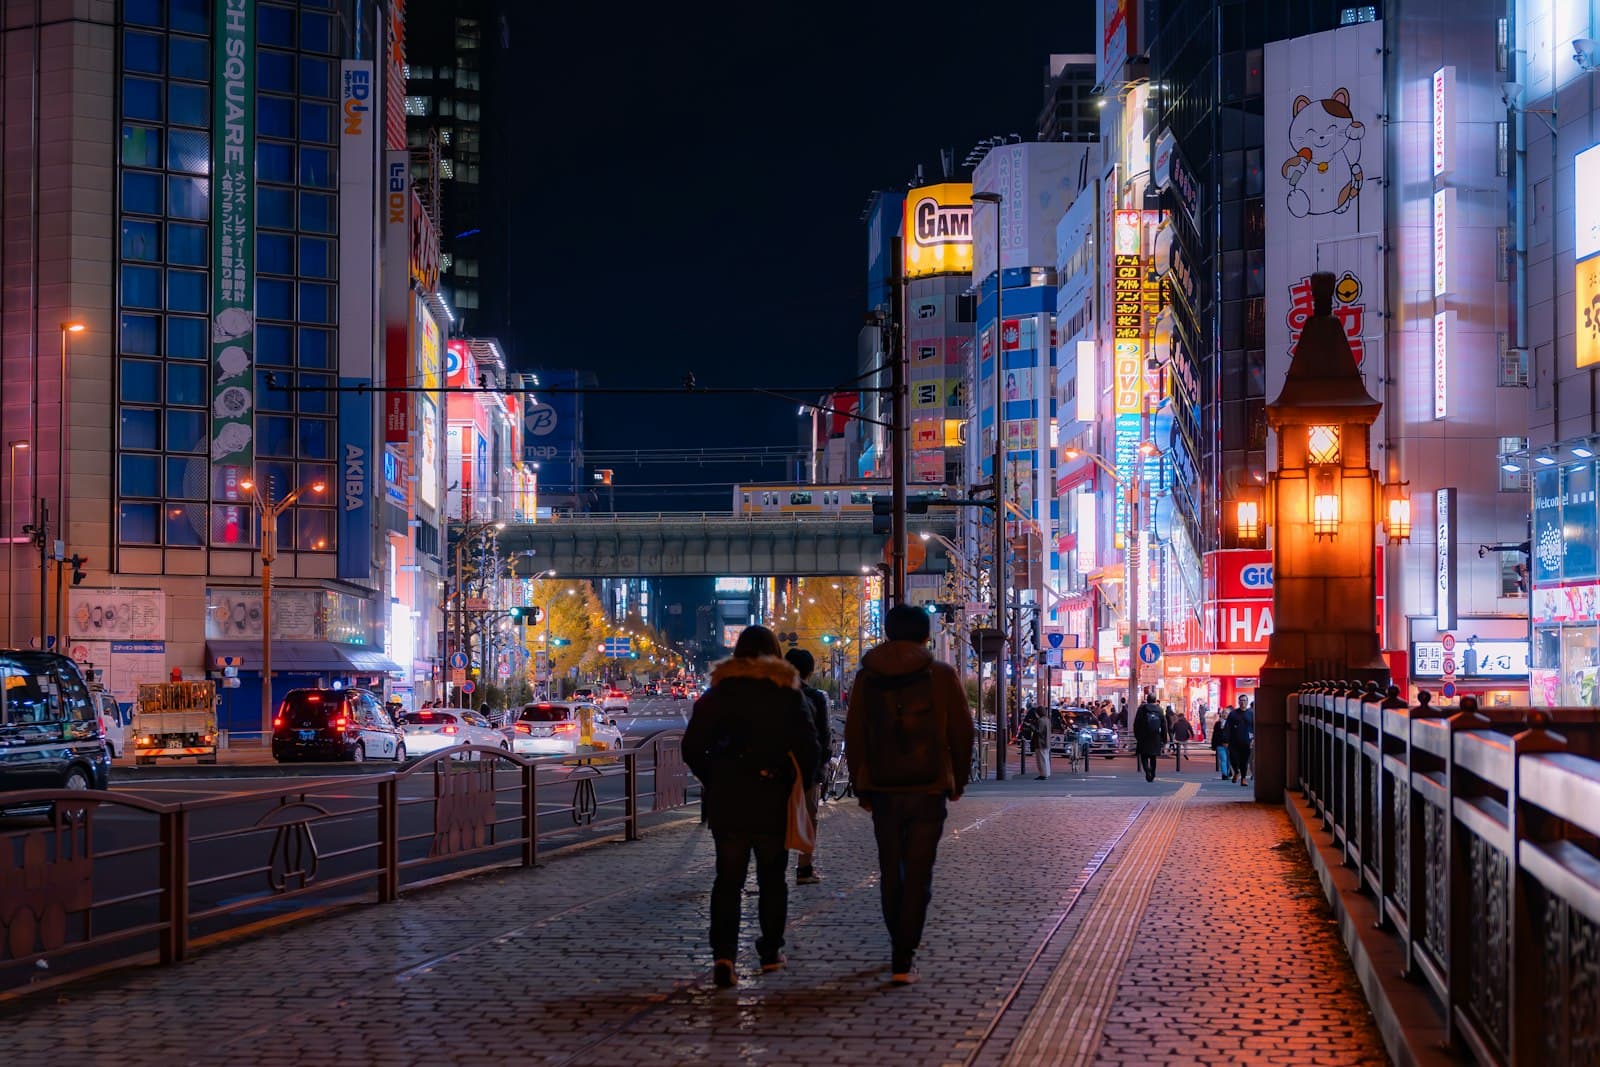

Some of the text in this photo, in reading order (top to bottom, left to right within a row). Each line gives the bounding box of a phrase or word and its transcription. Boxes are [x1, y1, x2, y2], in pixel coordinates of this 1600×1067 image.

[223, 38, 246, 165] SQUARE
[1000, 156, 1010, 247] AKIHABARA
[1012, 148, 1023, 245] WELCOME TO
[1117, 255, 1139, 266] ゲーム
[1119, 267, 1137, 278] CD
[1116, 292, 1140, 302] アニメ
[1117, 316, 1138, 326] ホビー
[1118, 359, 1139, 408] DVD
[346, 443, 364, 512] AKIBA
